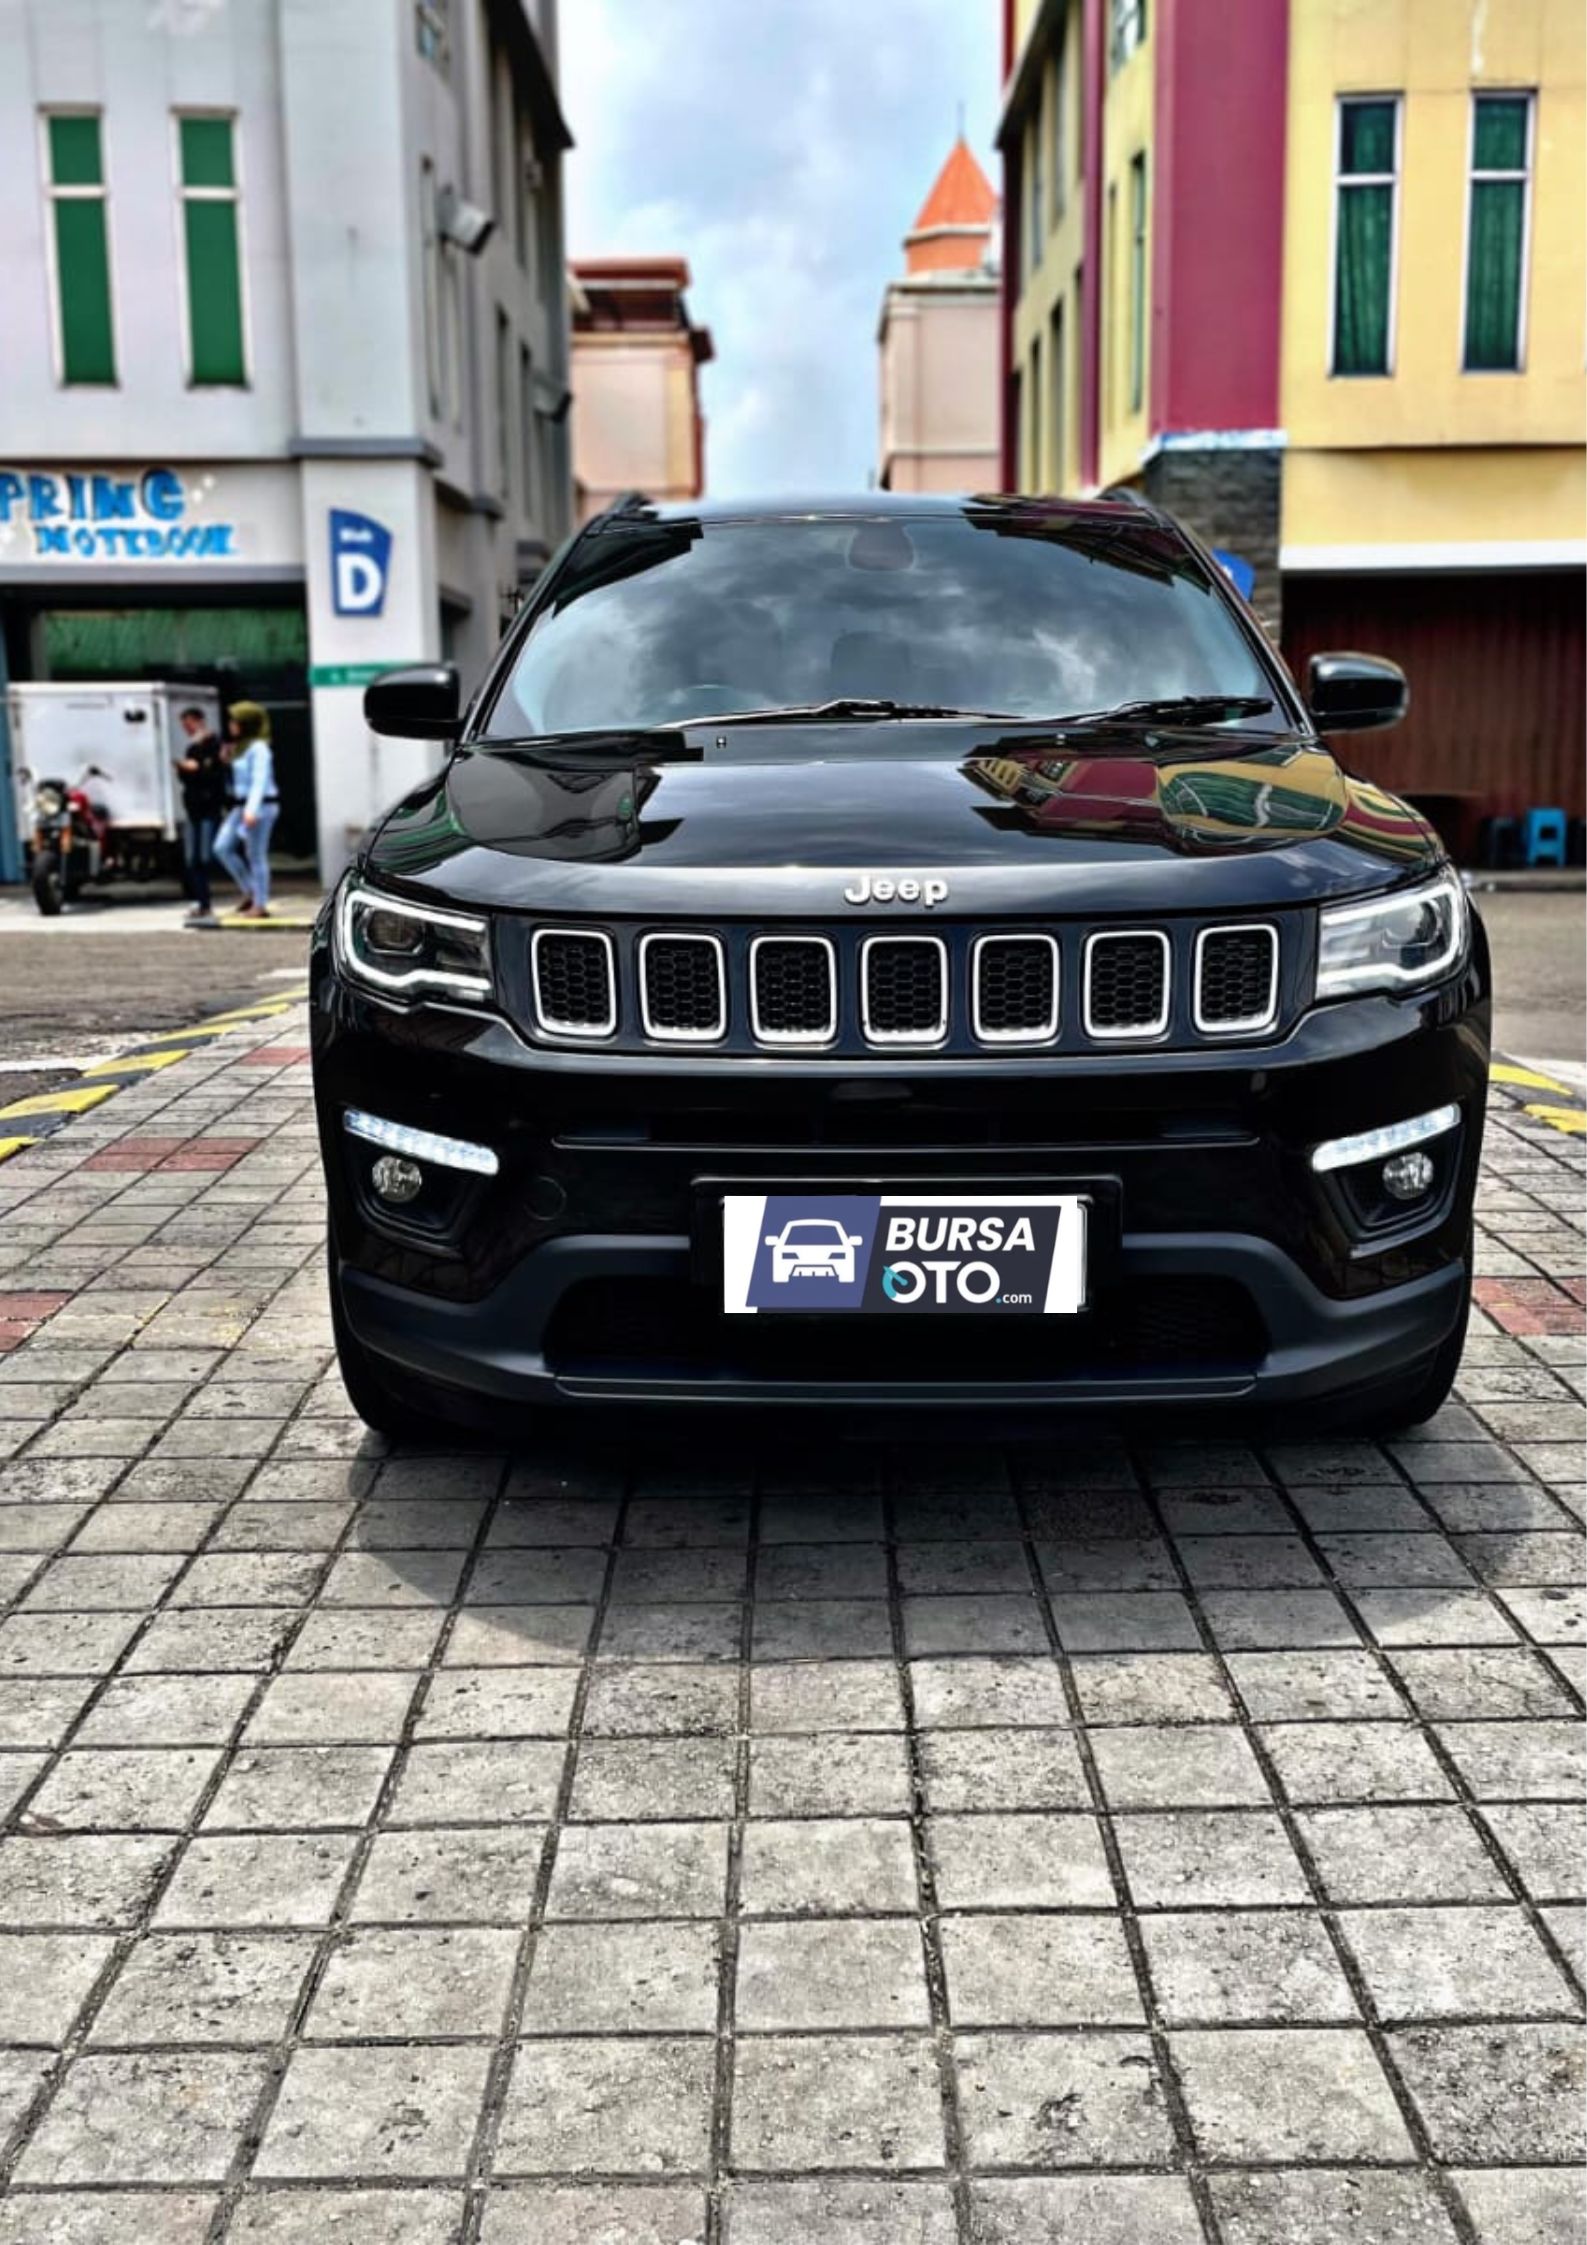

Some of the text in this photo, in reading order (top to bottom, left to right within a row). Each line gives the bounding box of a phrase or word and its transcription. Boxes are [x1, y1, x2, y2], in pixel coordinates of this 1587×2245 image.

[34, 525, 235, 556] NOTEBOOK
[338, 553, 382, 608] D
[844, 875, 949, 908] Jeep
